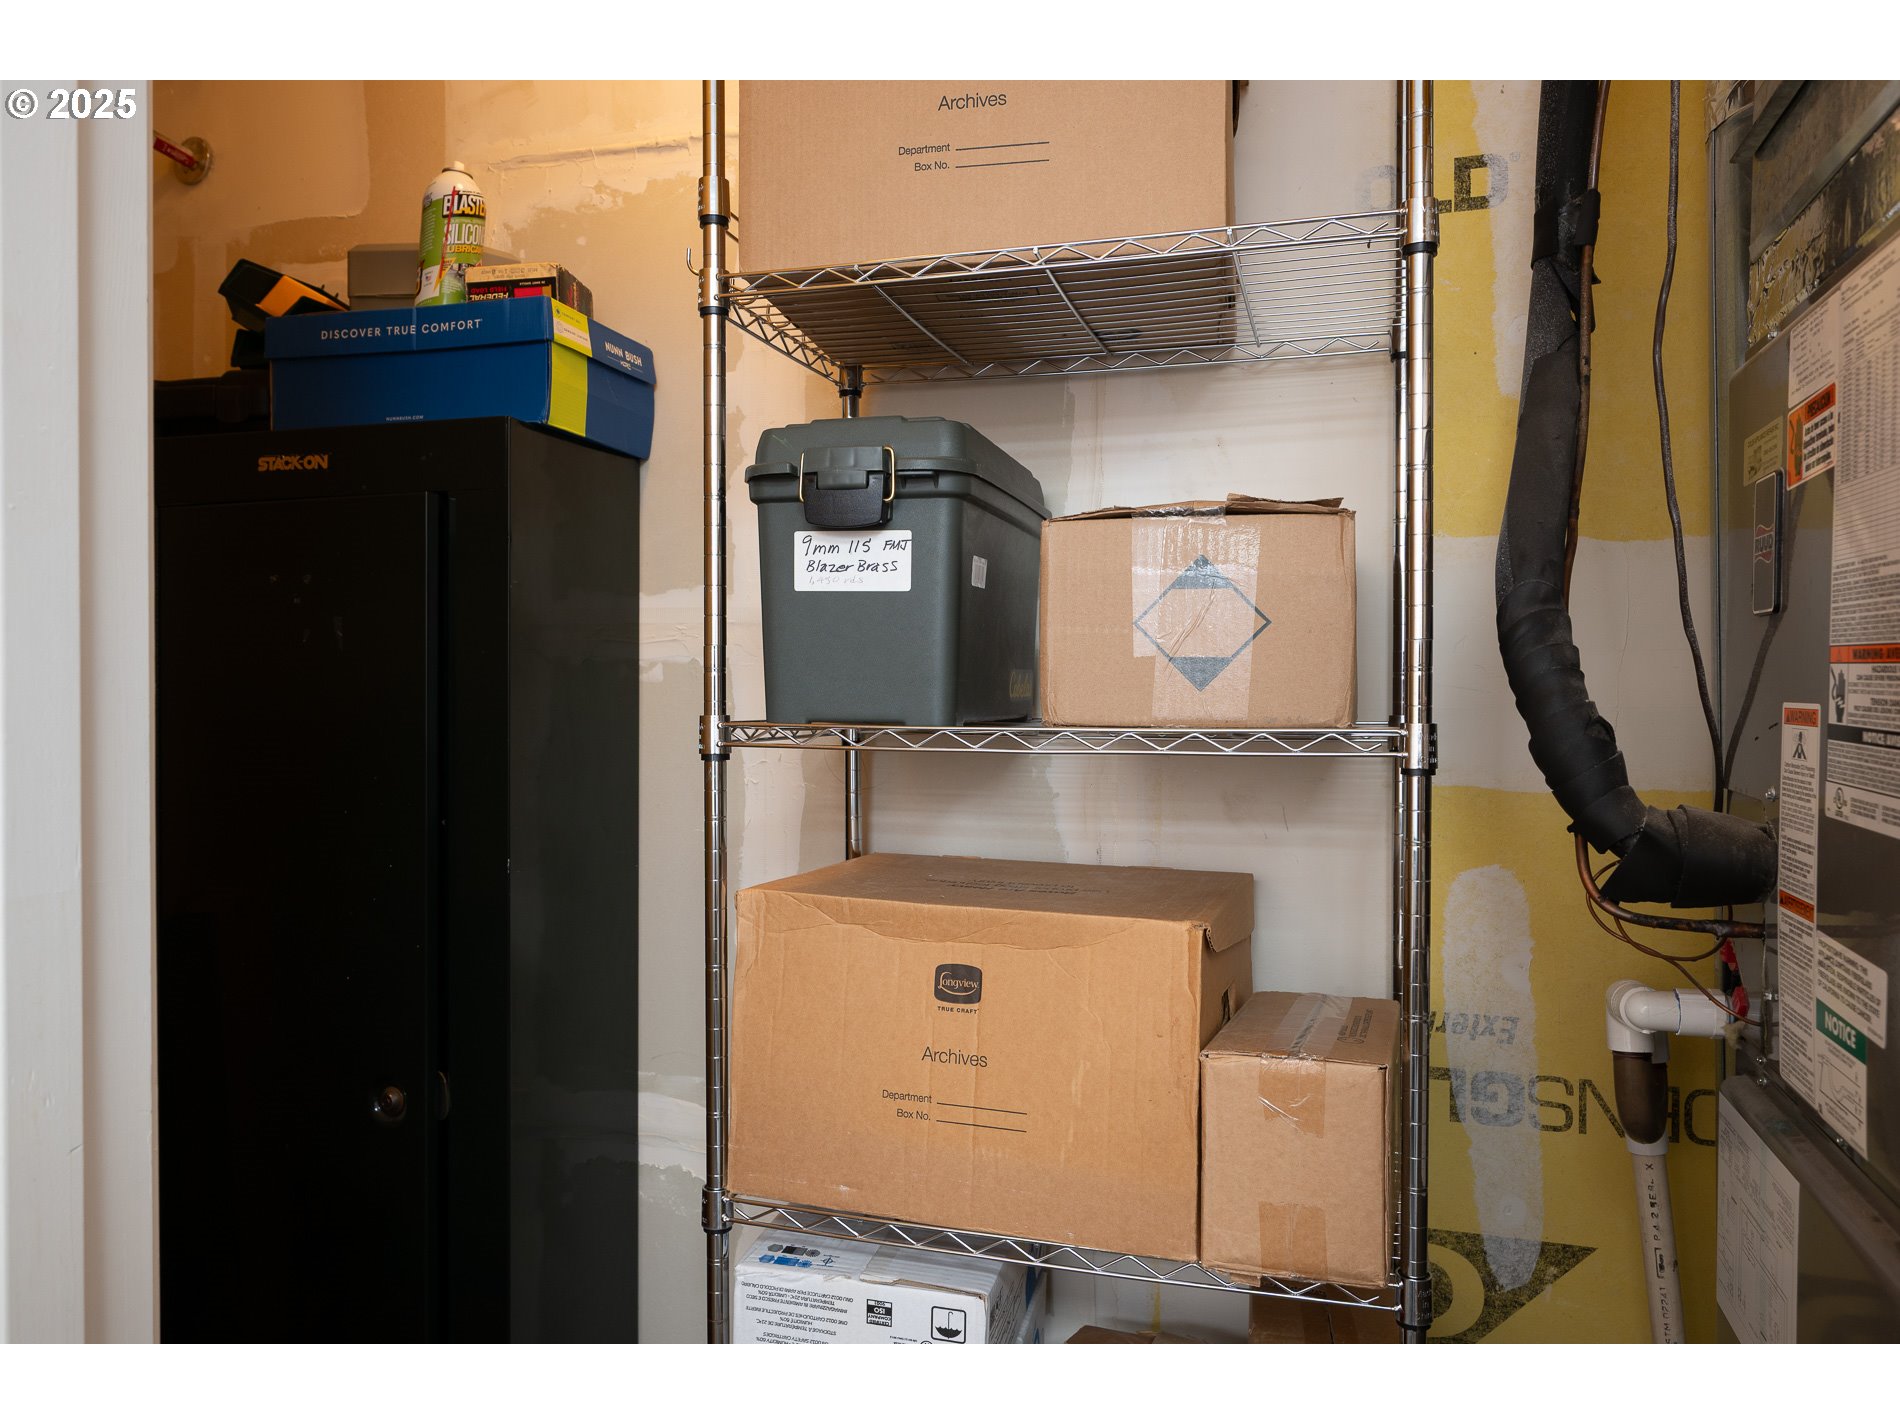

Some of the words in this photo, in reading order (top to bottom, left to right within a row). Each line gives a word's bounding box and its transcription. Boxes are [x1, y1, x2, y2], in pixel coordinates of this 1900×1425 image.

[938, 92, 1007, 111] Archives
[898, 143, 950, 156] Department
[914, 162, 932, 172] Box
[934, 160, 950, 170] No.
[320, 326, 382, 340] DISCOVER
[386, 324, 416, 336] TRUE
[421, 318, 482, 334] COMFORT
[604, 341, 624, 358] NUNN
[625, 350, 643, 367] BUSH
[258, 454, 328, 472] STACK-ON
[802, 534, 840, 556] 9mm
[883, 539, 912, 550] FMJ
[806, 560, 854, 572] Blazer
[857, 560, 898, 572] Brass
[1789, 710, 1816, 724] WARNING
[1824, 1010, 1856, 1048] NOTICE
[921, 1046, 988, 1068] Archives
[882, 1089, 932, 1104] Department
[896, 1108, 914, 1120] Box
[916, 1110, 931, 1122] No.
[801, 1295, 835, 1306] TEMPERATURA
[763, 1331, 792, 1340] CARTRIDGES
[812, 1327, 836, 1336] STOCKAGE
